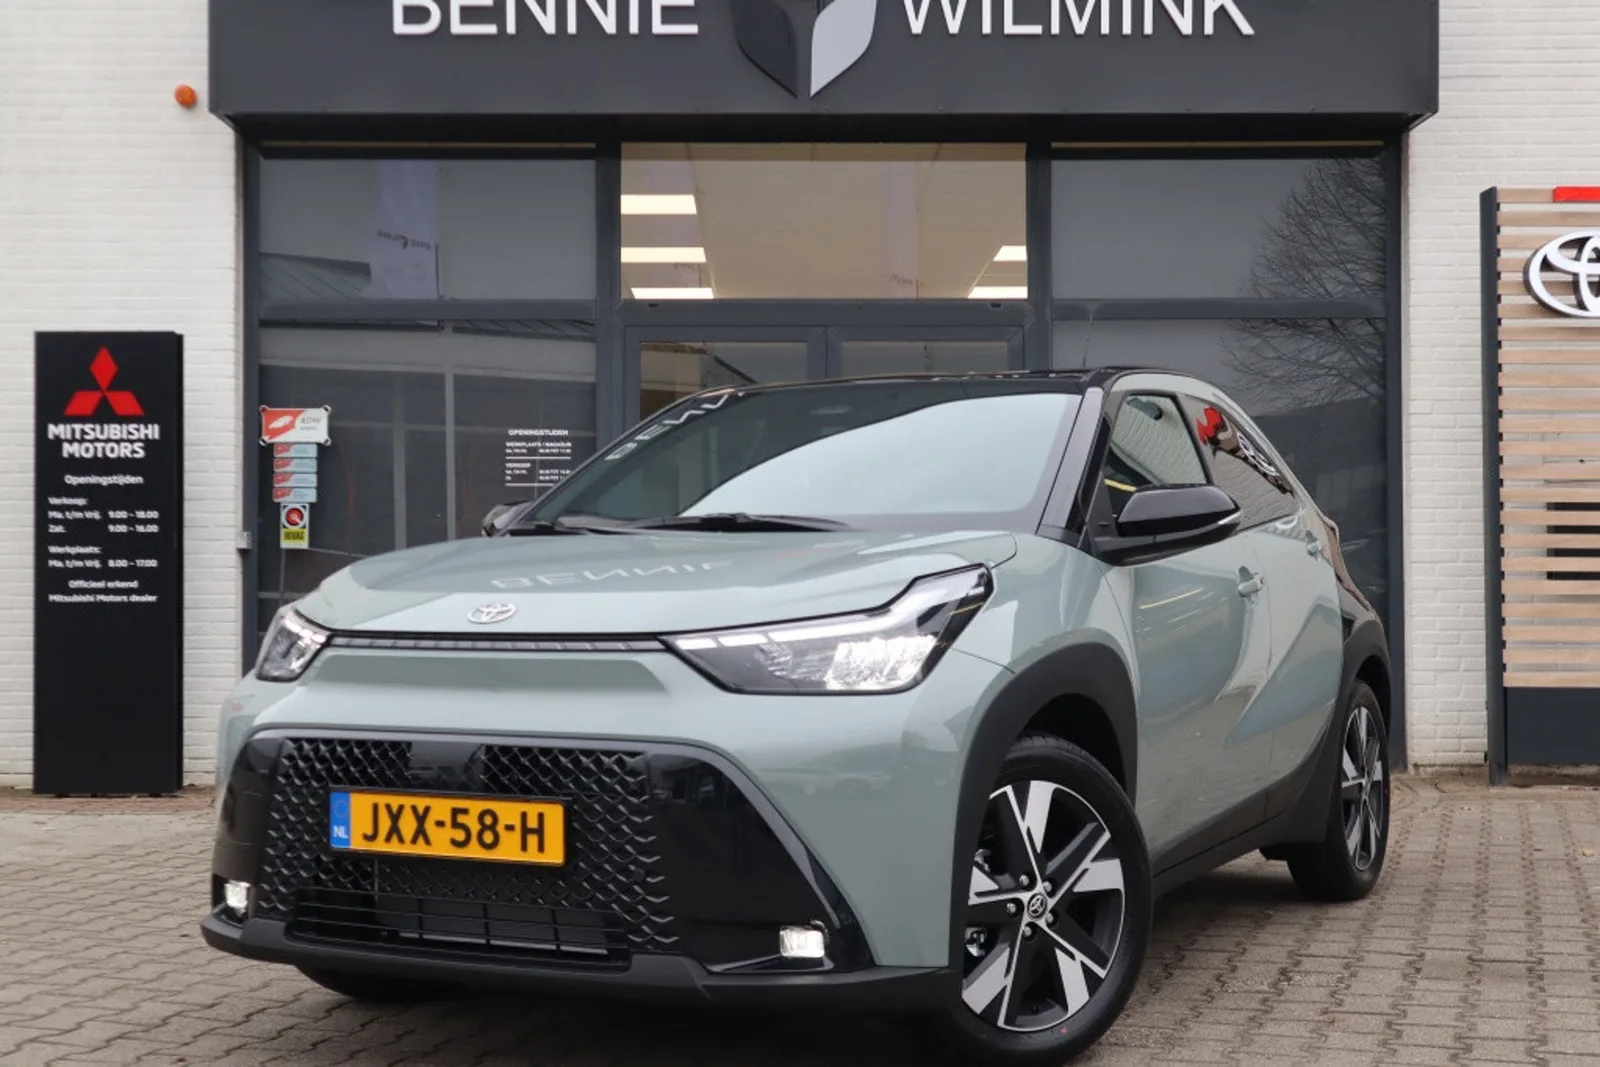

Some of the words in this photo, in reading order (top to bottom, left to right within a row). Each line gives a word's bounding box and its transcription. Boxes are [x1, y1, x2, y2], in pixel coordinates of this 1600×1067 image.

[47, 423, 160, 440] MITSUBISHI
[62, 441, 146, 458] MOTORS
[64, 474, 144, 486] Openingstijden
[129, 594, 158, 602] dealer
[333, 826, 349, 839] NL
[362, 802, 546, 853] JXX-58-H
